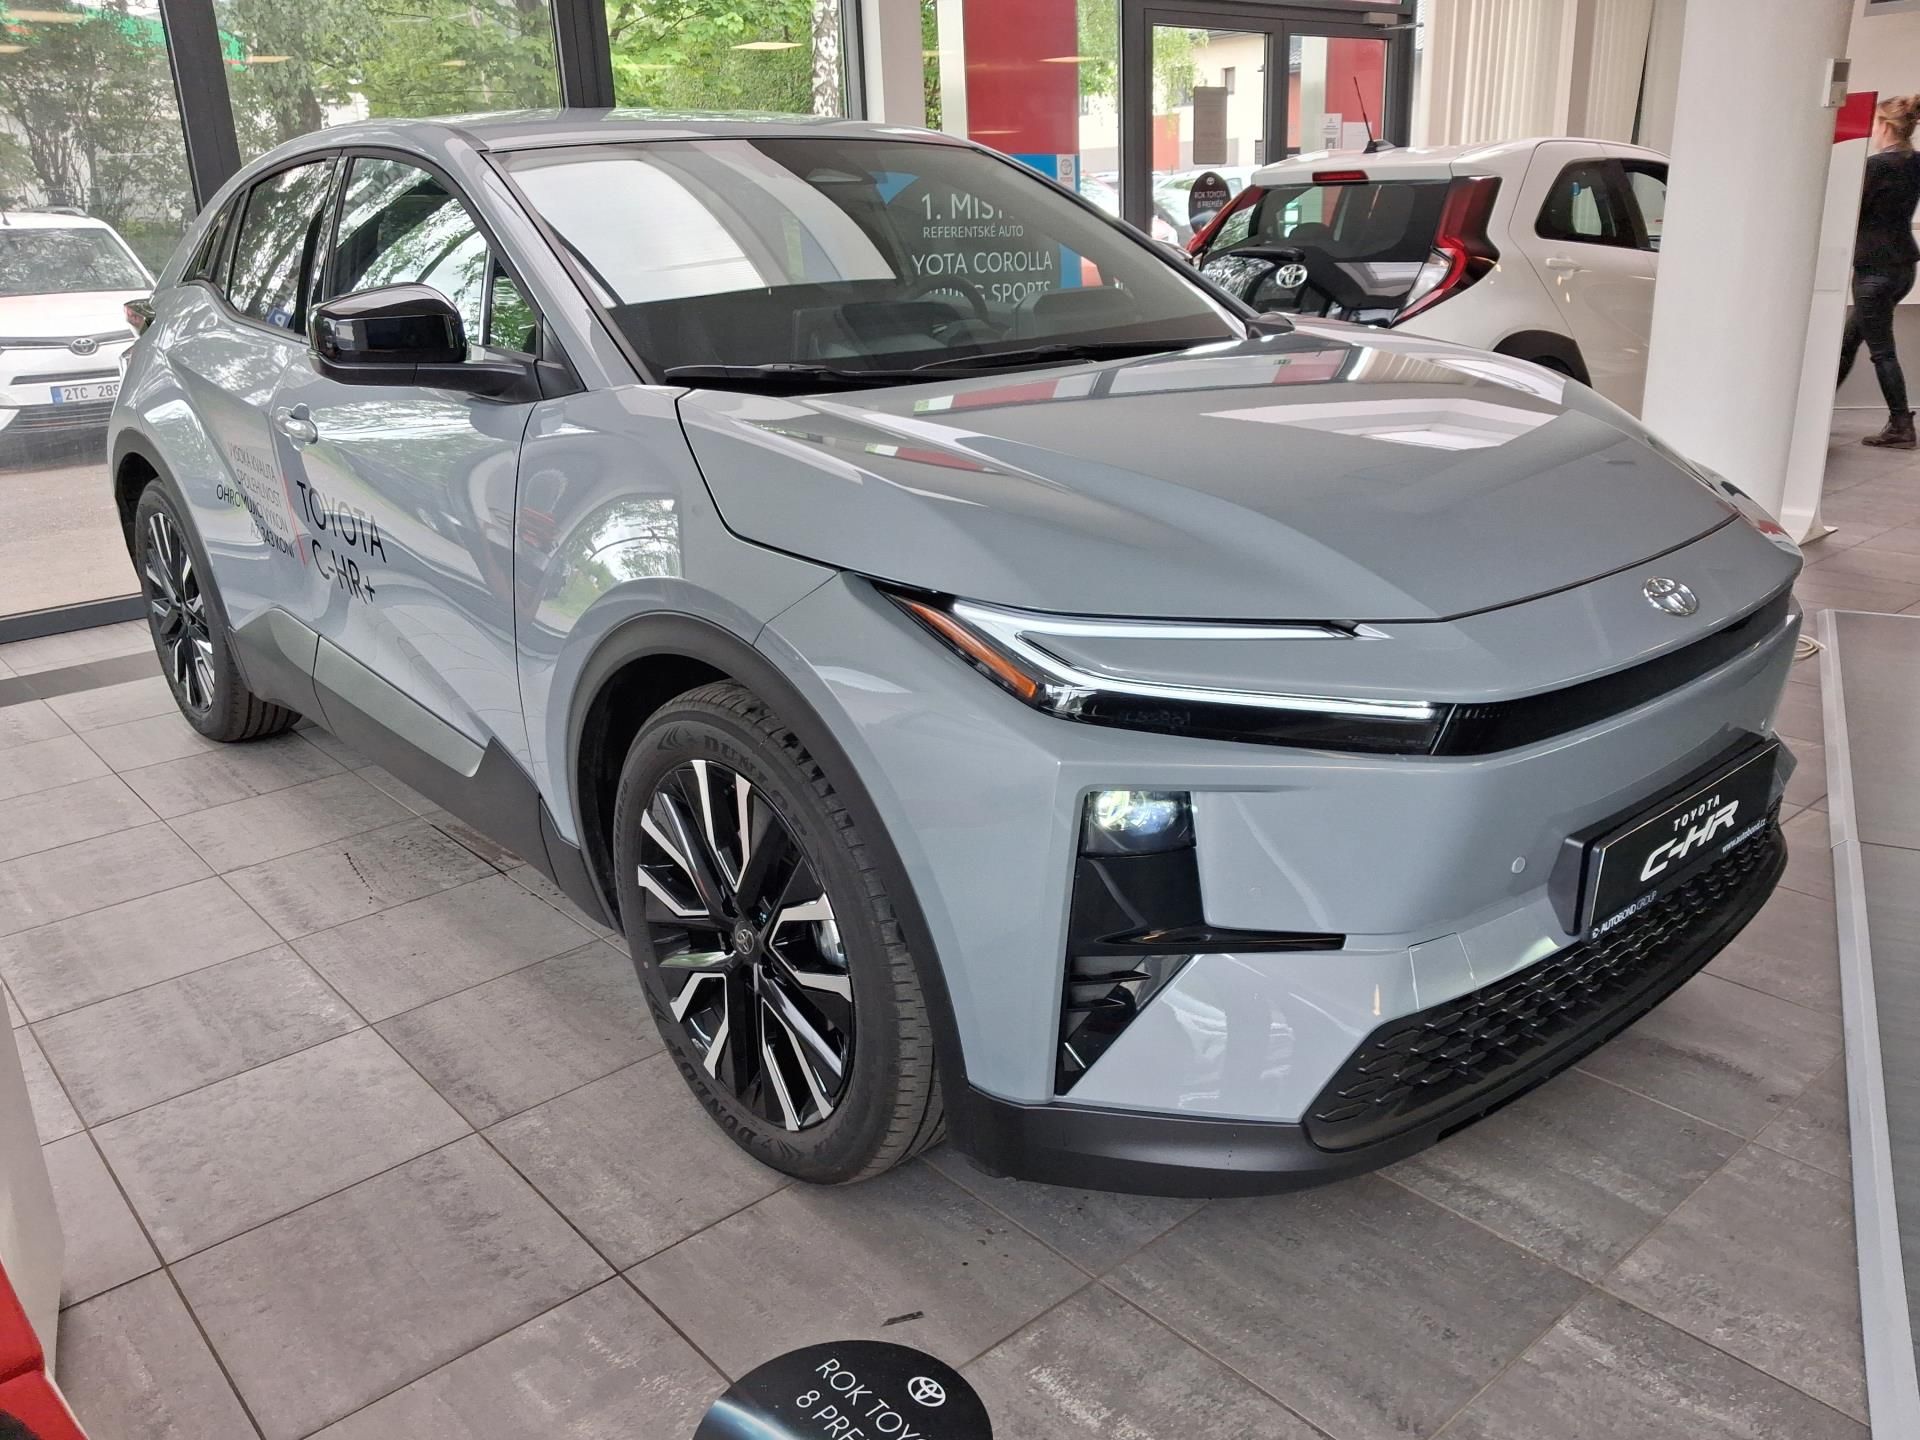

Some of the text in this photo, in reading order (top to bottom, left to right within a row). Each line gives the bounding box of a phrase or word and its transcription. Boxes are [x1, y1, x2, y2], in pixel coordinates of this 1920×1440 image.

[921, 193, 942, 220] 1.
[923, 223, 1024, 239] REFERENTSKÉ AUTO
[974, 251, 1053, 273] COROLLA
[64, 387, 88, 400] 2TC
[296, 480, 387, 563] TOYOTA
[312, 539, 376, 605] C-HR+
[1673, 794, 1720, 831] TOYOTA
[1640, 800, 1739, 882] C-HR
[1600, 904, 1637, 934] AUTOBOND
[796, 1390, 869, 1440] 8 PRE
[816, 1358, 929, 1440] ROK TOY
